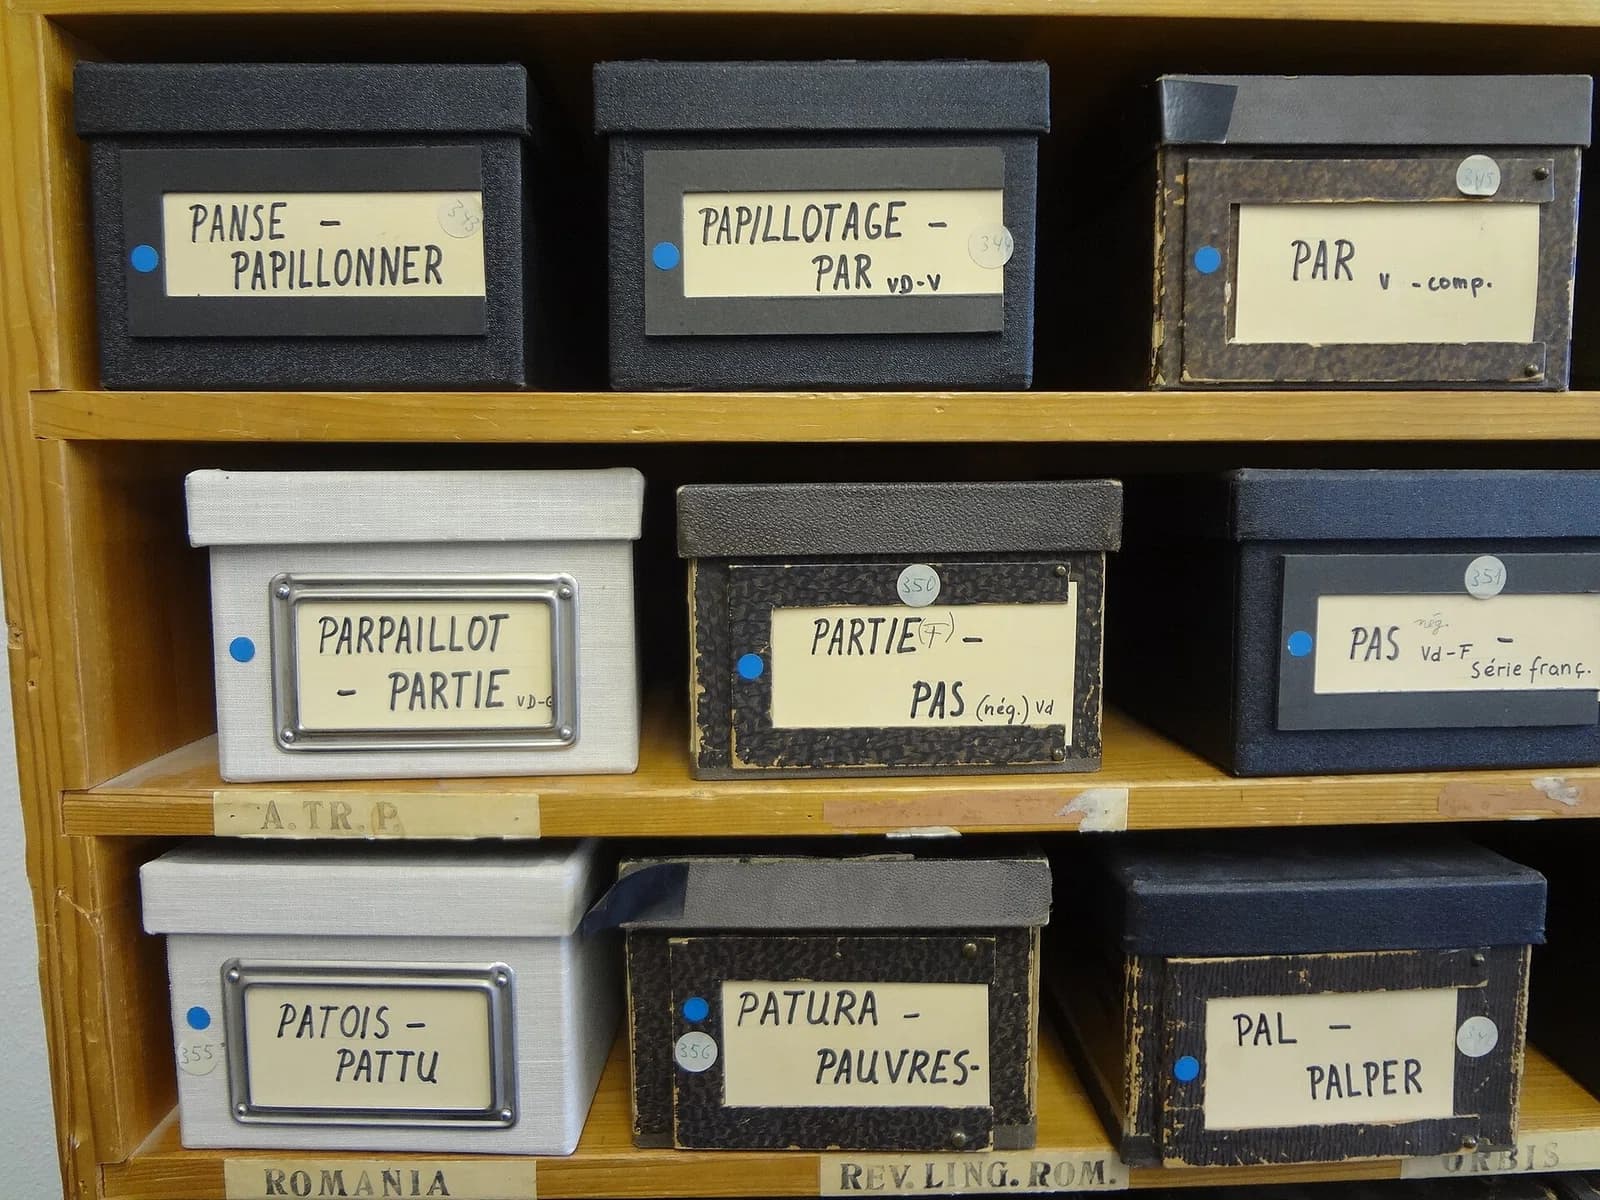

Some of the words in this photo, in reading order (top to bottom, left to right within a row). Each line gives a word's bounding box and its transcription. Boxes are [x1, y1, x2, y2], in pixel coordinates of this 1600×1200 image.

[189, 201, 287, 243] PANSE
[698, 200, 907, 246] PAPILLOTAGE
[231, 244, 444, 291] PAPILLONNER
[811, 253, 873, 292] PAR
[1291, 238, 1356, 282] PAR
[318, 613, 511, 655] PARPAILLOT
[1349, 626, 1400, 662] PAS
[1529, 655, 1592, 683] franç.
[388, 669, 511, 712] PARTIE
[910, 680, 966, 720] PAS
[976, 694, 1030, 724] (nég.)
[276, 1002, 390, 1039] PATOIS
[736, 989, 879, 1027] PATURA
[1232, 1011, 1298, 1047] PAL
[335, 1048, 440, 1084] PATTU
[1306, 1058, 1423, 1100] PALPER
[263, 1167, 451, 1198] ROMANIA
